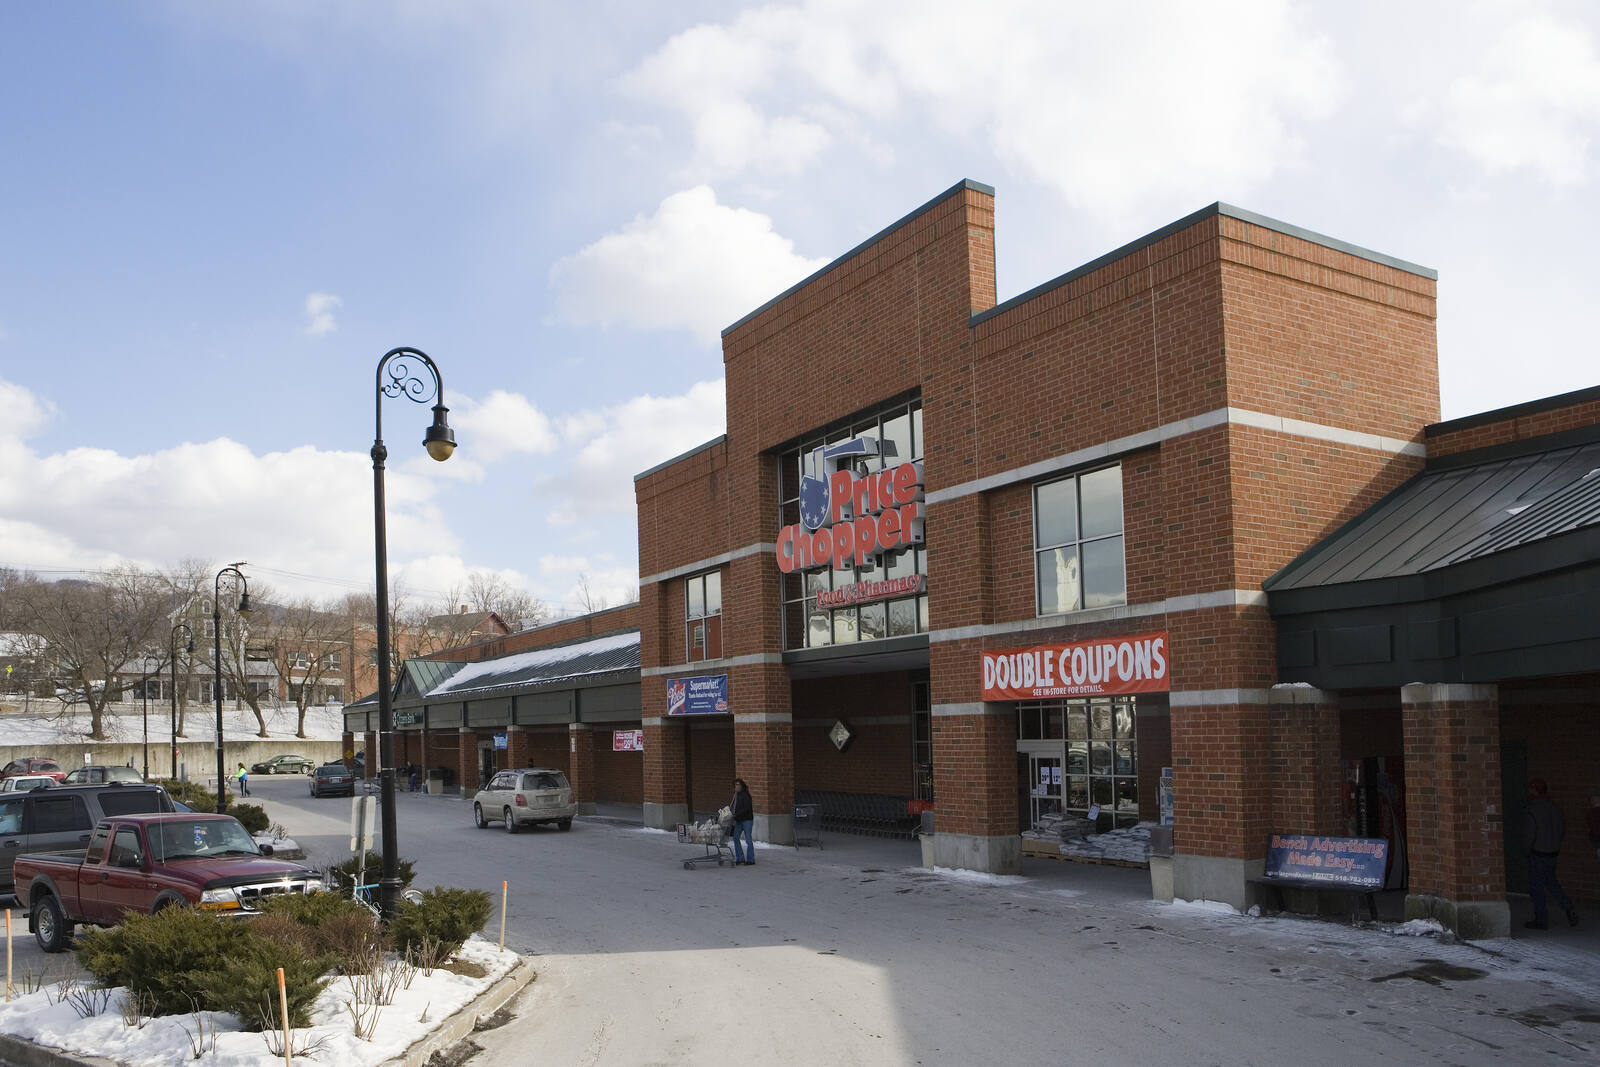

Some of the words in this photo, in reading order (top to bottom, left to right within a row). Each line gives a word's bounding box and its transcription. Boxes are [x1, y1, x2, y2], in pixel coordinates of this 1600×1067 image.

[831, 463, 917, 522] Price
[776, 502, 917, 573] Chopper
[816, 586, 844, 607] Food
[845, 584, 856, 602] &
[856, 574, 921, 599] Pharmacy
[984, 650, 1054, 690] DOUBLE
[1059, 638, 1166, 685] COUPONS
[1033, 688, 1042, 697] SEE
[1043, 686, 1067, 695] IN-STORE
[1068, 686, 1080, 694] FOR
[1271, 835, 1308, 850] Bench
[1310, 837, 1385, 858] Advertising
[1287, 852, 1322, 867] Made
